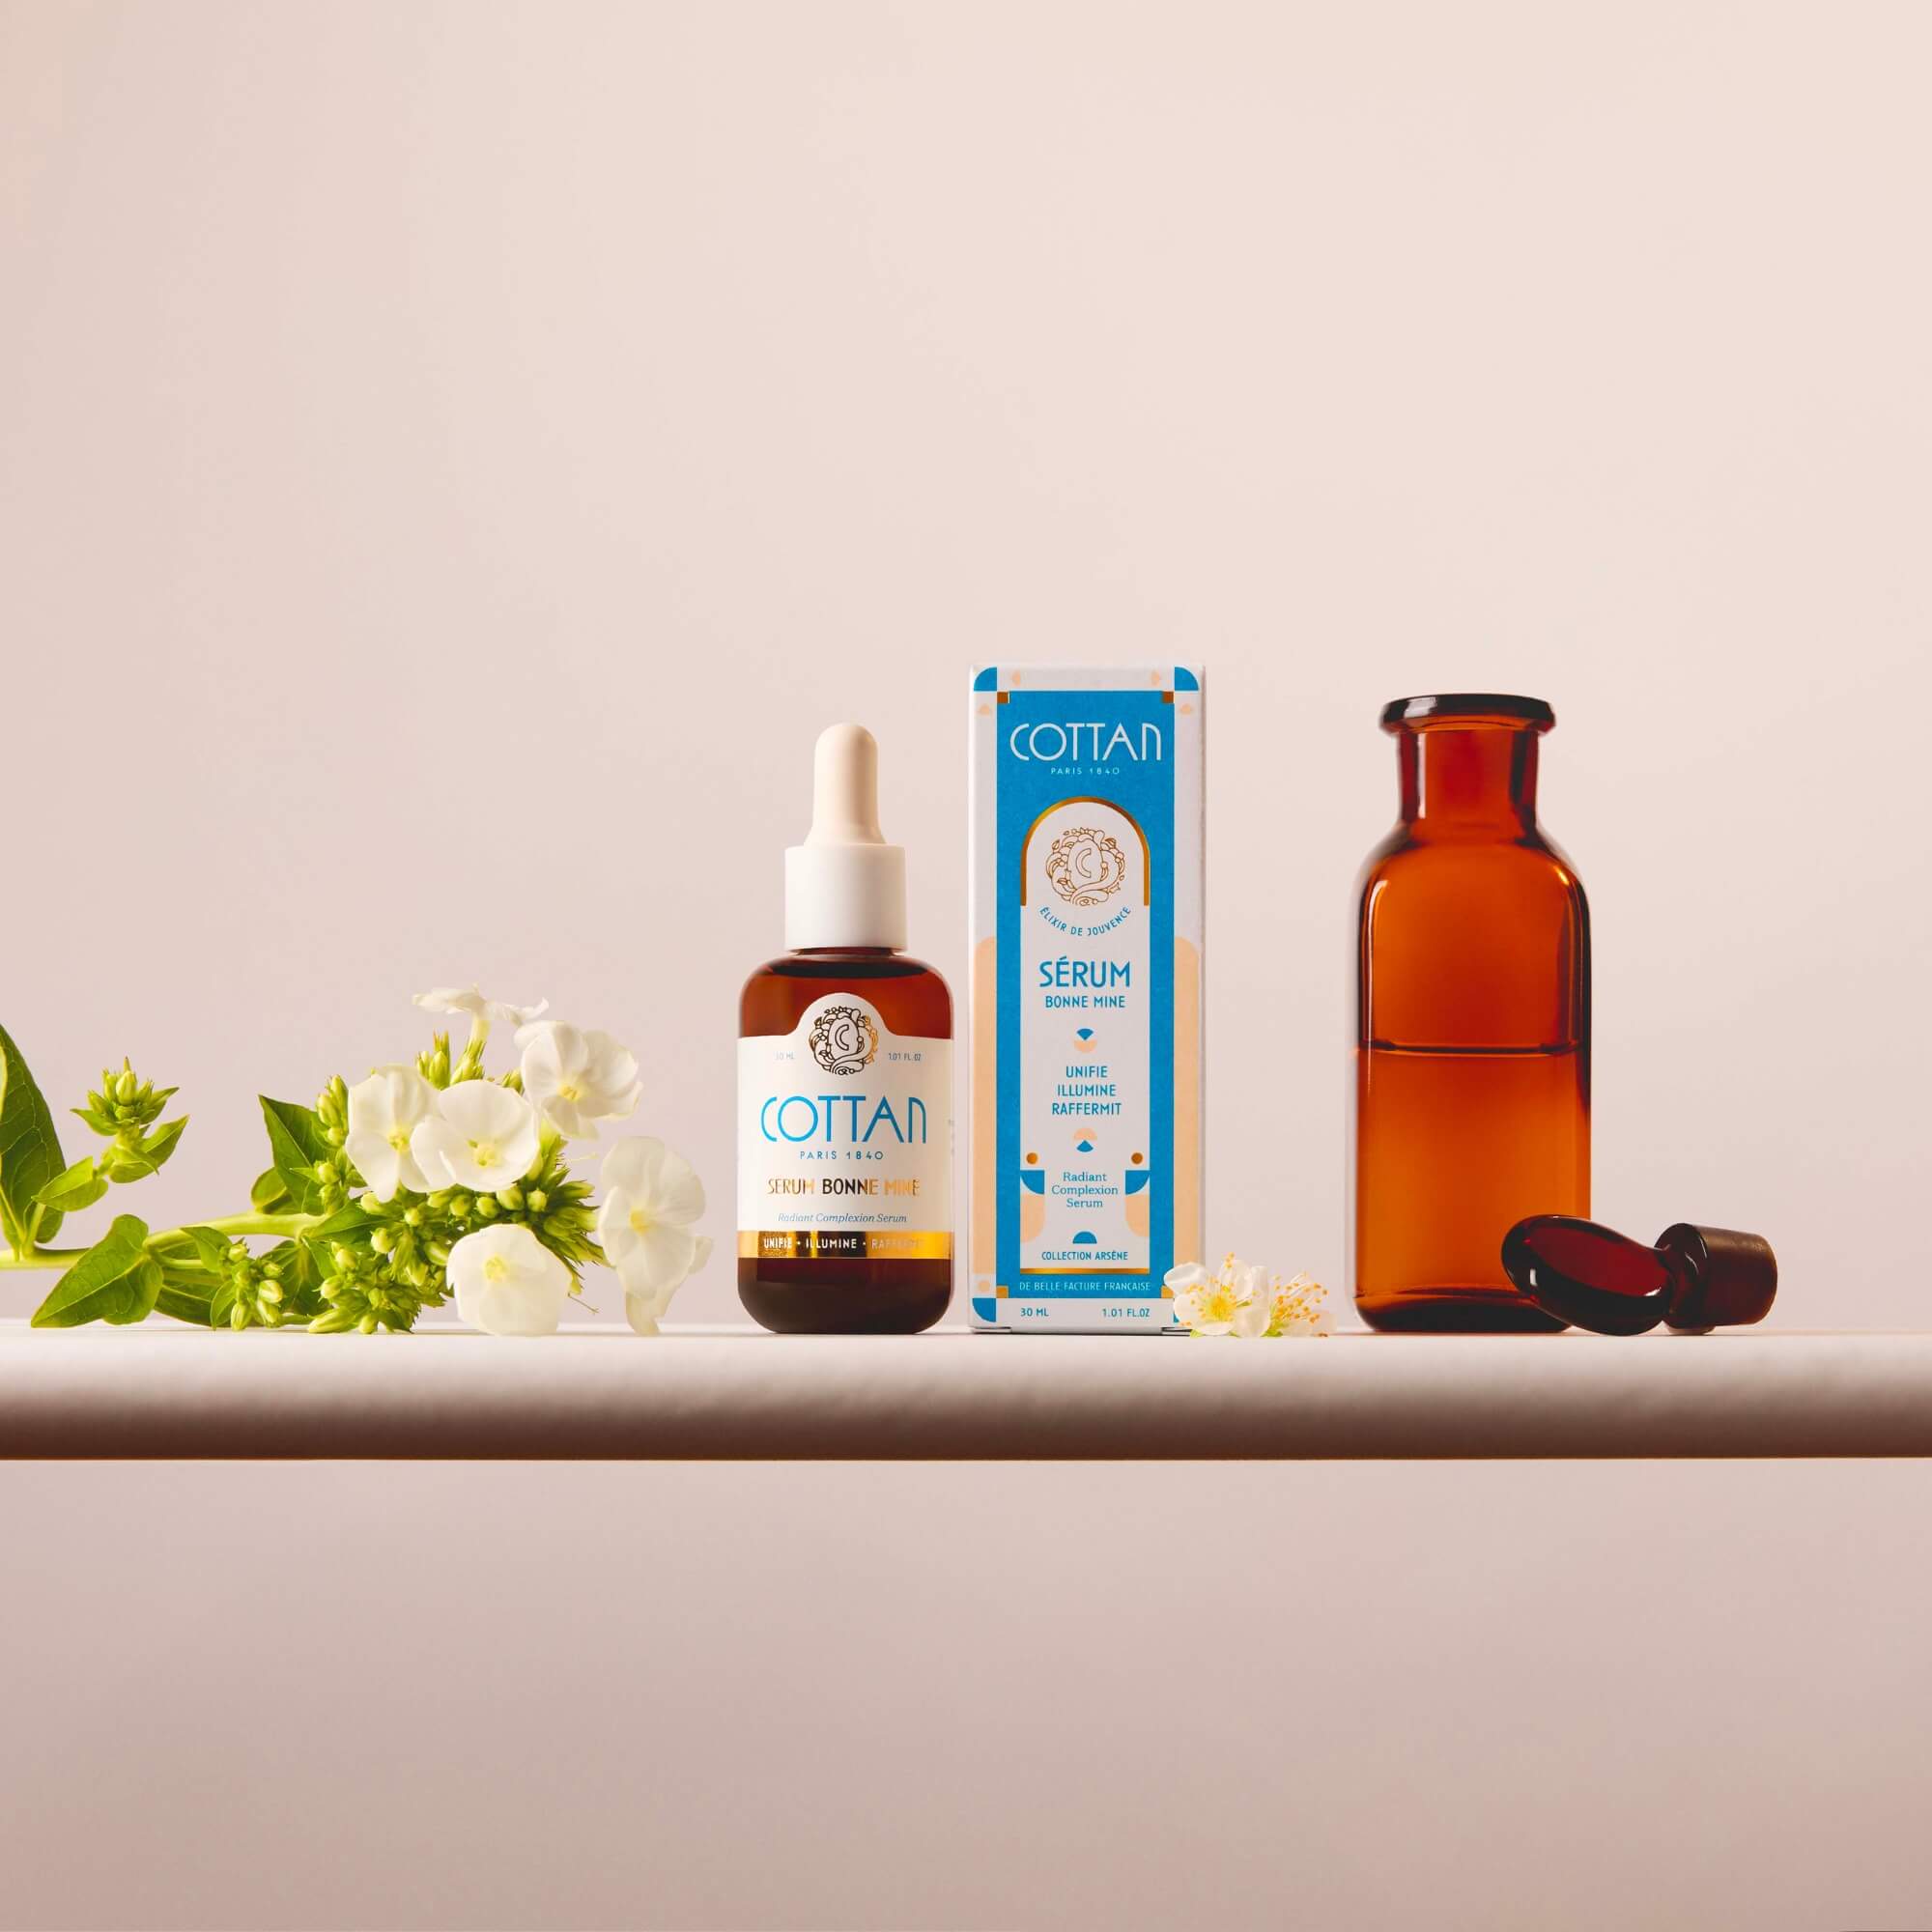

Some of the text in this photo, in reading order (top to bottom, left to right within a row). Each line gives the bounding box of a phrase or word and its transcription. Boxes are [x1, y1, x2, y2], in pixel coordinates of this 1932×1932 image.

[1009, 722, 1162, 761] COTTAN
[1050, 766, 1121, 775] PARIS 1840
[1070, 926, 1083, 936] DE
[1087, 905, 1131, 936] JOUVENCE
[1038, 955, 1130, 988] SÉRUM
[1045, 995, 1125, 1009] BONNE MINE
[1065, 1065, 1108, 1078] UNIFIE
[1057, 1084, 1117, 1097] ILLUMINE
[1052, 1102, 1122, 1116] RAFFERMIT
[760, 1094, 927, 1144] COTTAN
[800, 1150, 884, 1160] PARIS 1840
[1063, 1171, 1107, 1182] Radiant
[822, 1178, 879, 1196] BONNE
[1051, 1184, 1119, 1196] Complexion
[1065, 1197, 1103, 1208] Serum
[778, 1212, 907, 1225] Radiant Complexion Serum
[763, 1237, 793, 1249] UNIFIE
[805, 1237, 858, 1249] ILLUMINE
[1041, 1251, 1092, 1261] COLLECTION
[1019, 1281, 1031, 1292] DE
[1034, 1281, 1061, 1292] BELLE
[1064, 1281, 1101, 1292] FACTURE
[1020, 1307, 1050, 1318] 30 ML
[1102, 1308, 1122, 1318] 1.01
